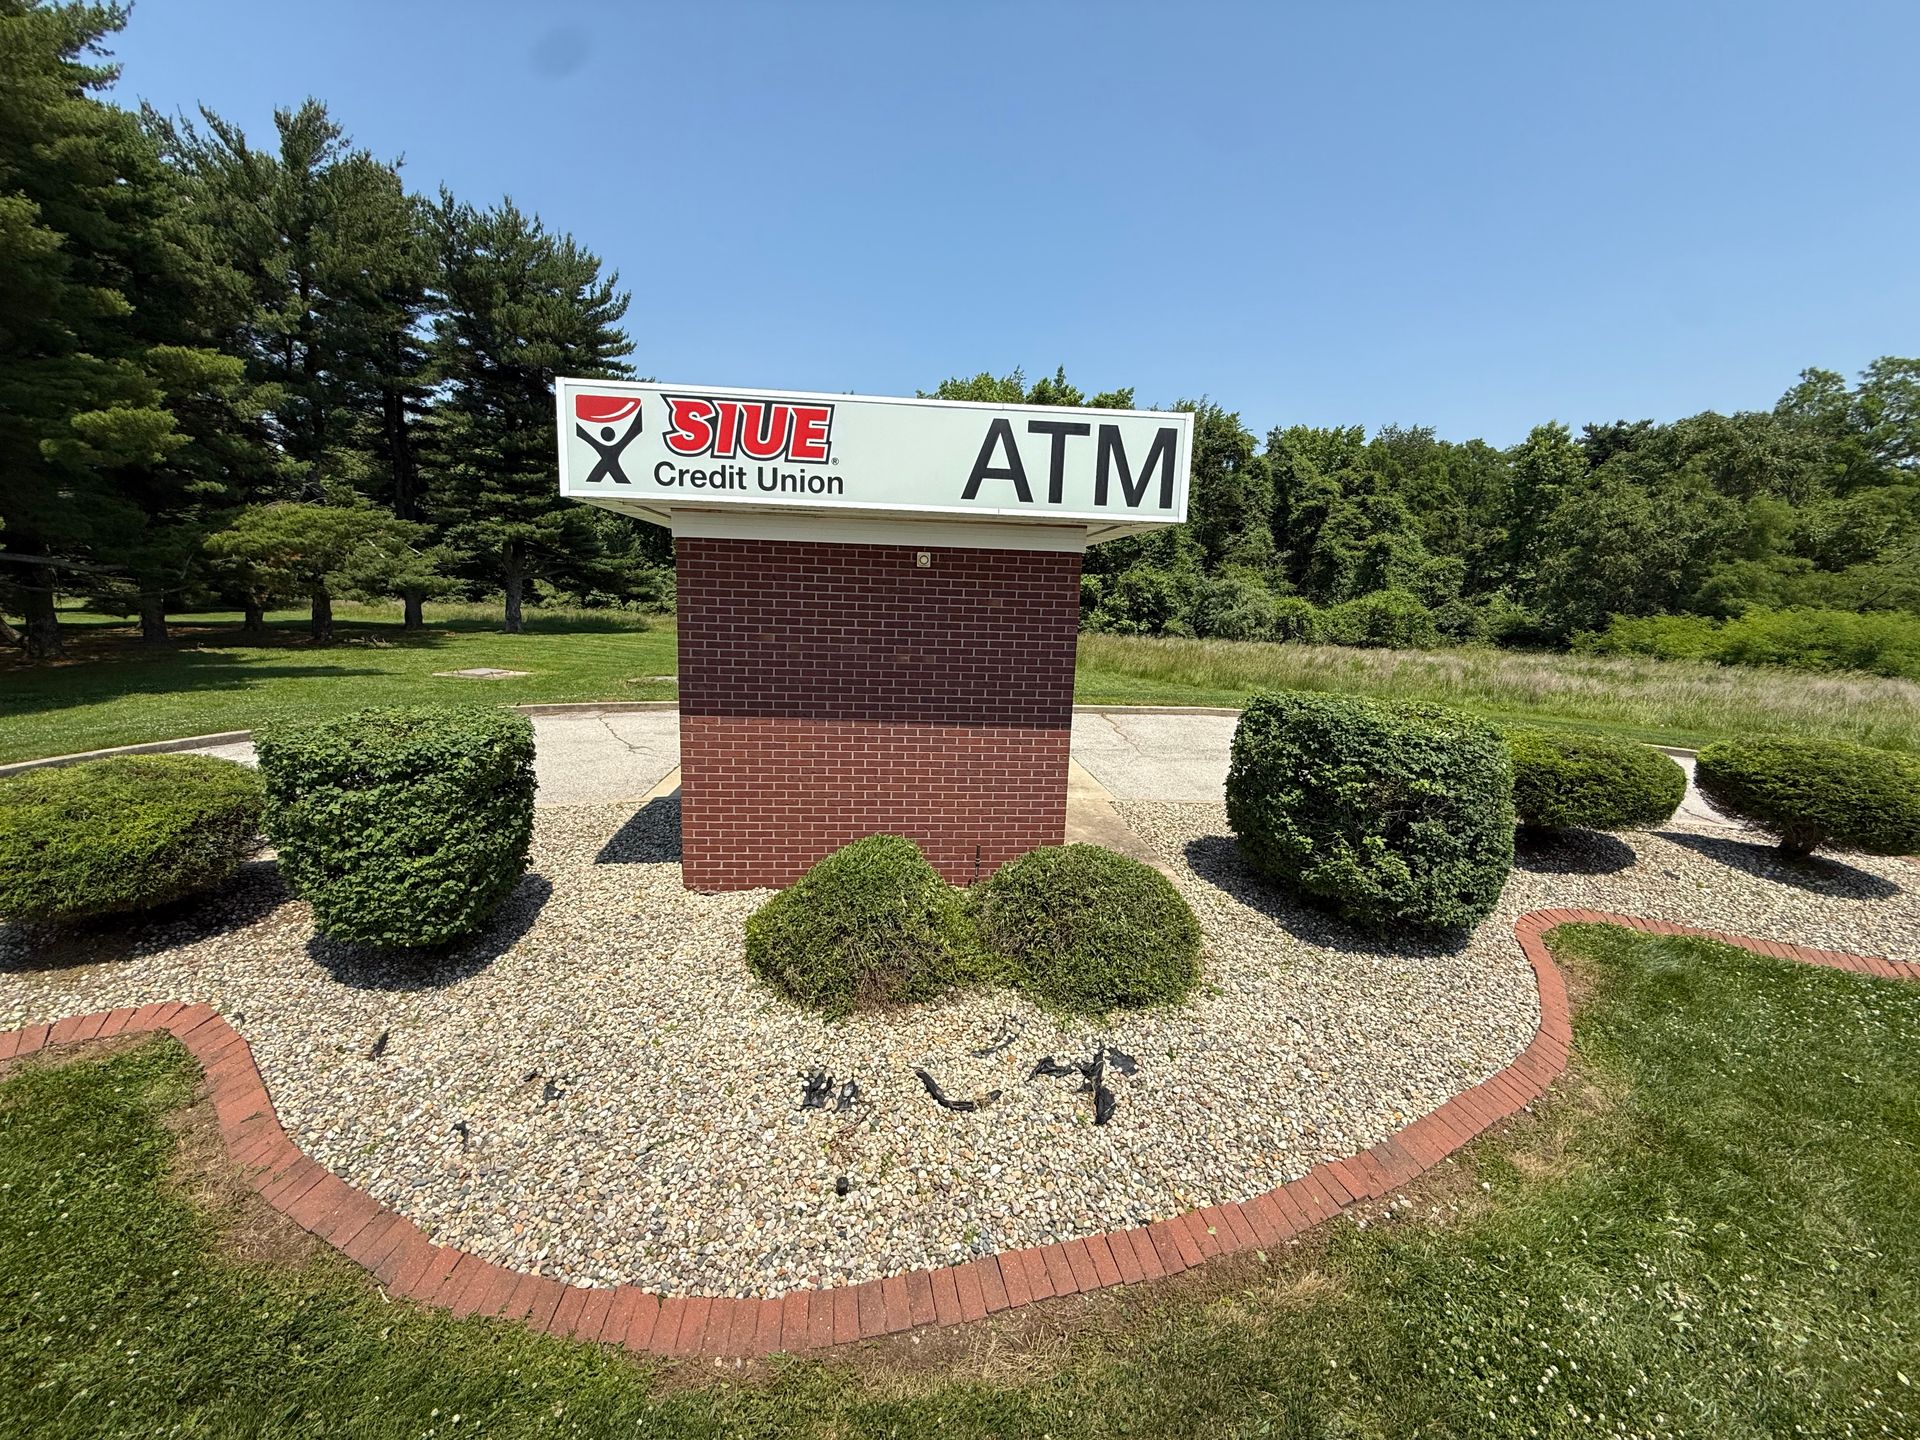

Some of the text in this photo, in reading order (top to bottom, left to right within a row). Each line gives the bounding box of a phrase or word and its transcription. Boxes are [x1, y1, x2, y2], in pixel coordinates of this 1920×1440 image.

[661, 394, 835, 464] SIUE
[960, 418, 1178, 509] ATM
[654, 461, 844, 494] Credit Union
